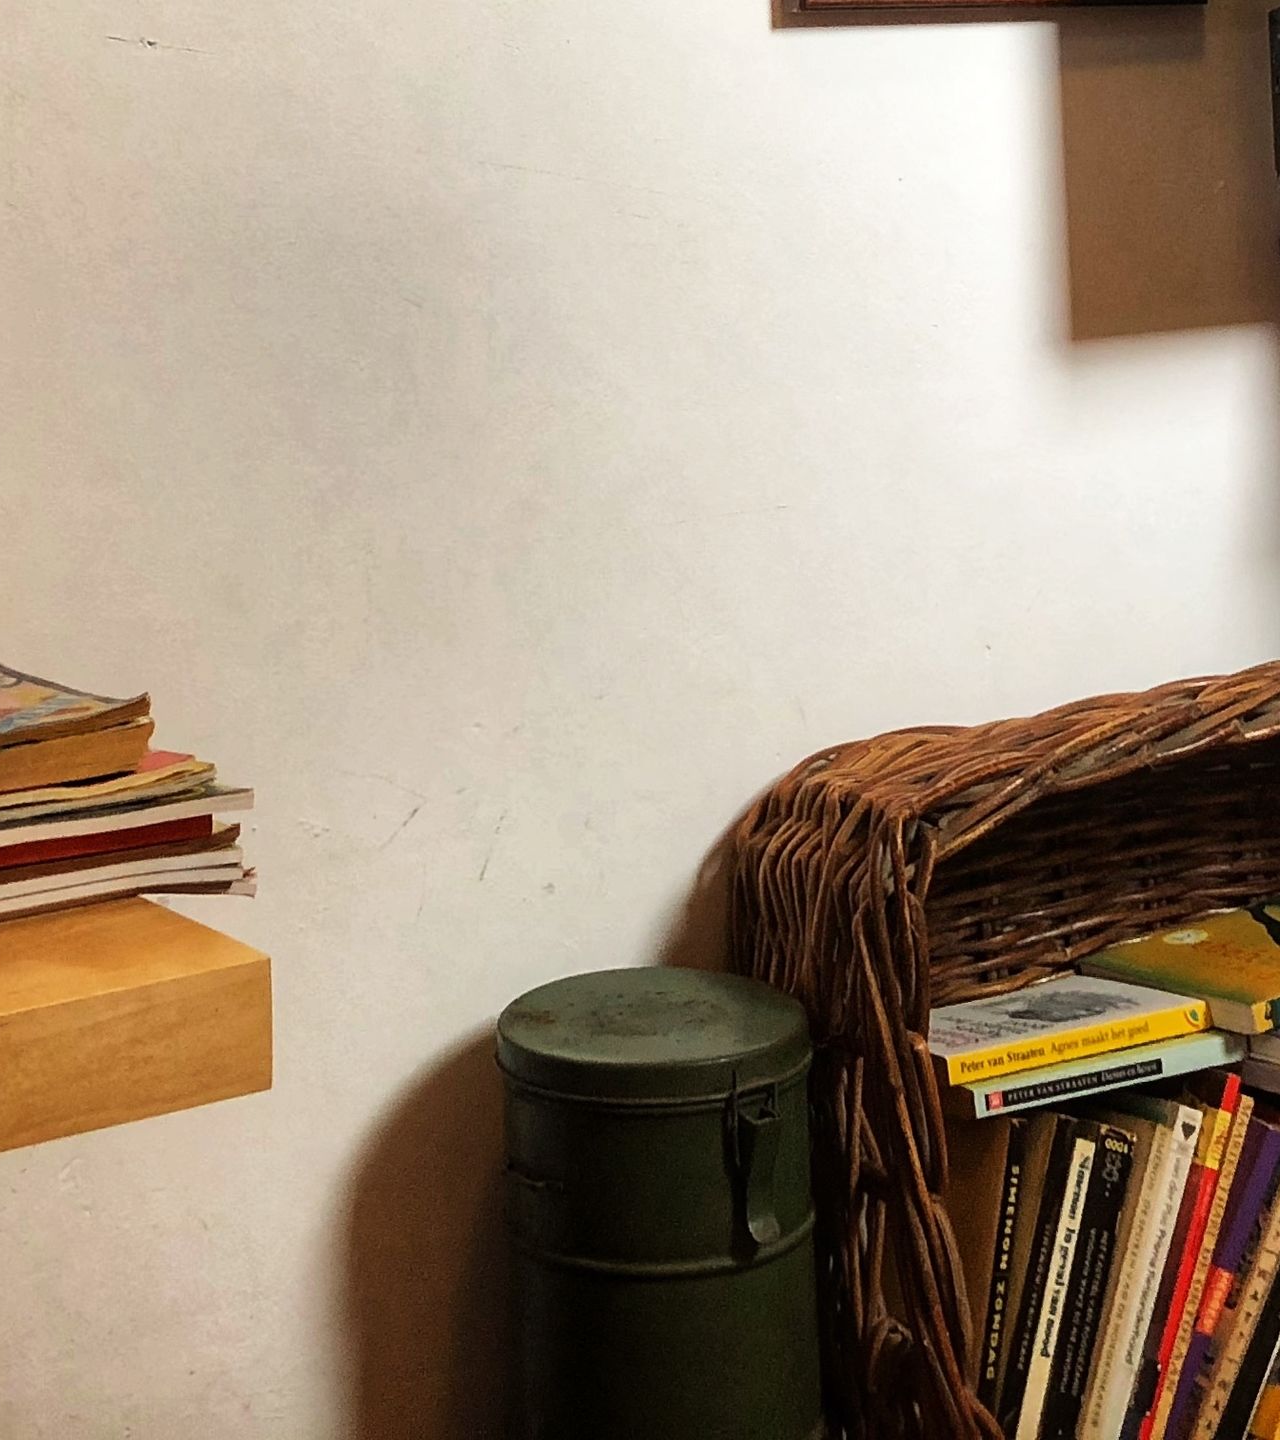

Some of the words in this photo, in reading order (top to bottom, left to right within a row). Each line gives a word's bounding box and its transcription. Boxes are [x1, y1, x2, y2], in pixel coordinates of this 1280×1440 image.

[959, 1056, 984, 1072] Peter
[986, 1054, 1004, 1066] van
[1005, 1043, 1045, 1062] Straaten
[1080, 1029, 1109, 1045] maakt
[1126, 1019, 1149, 1037] goed
[1007, 1088, 1034, 1101] PETER
[1036, 1083, 1053, 1094] VAN
[1055, 1074, 1098, 1090] STRAATEN
[1000, 1164, 1021, 1270] SIMENON
[985, 1279, 1006, 1381] ZONDAG
